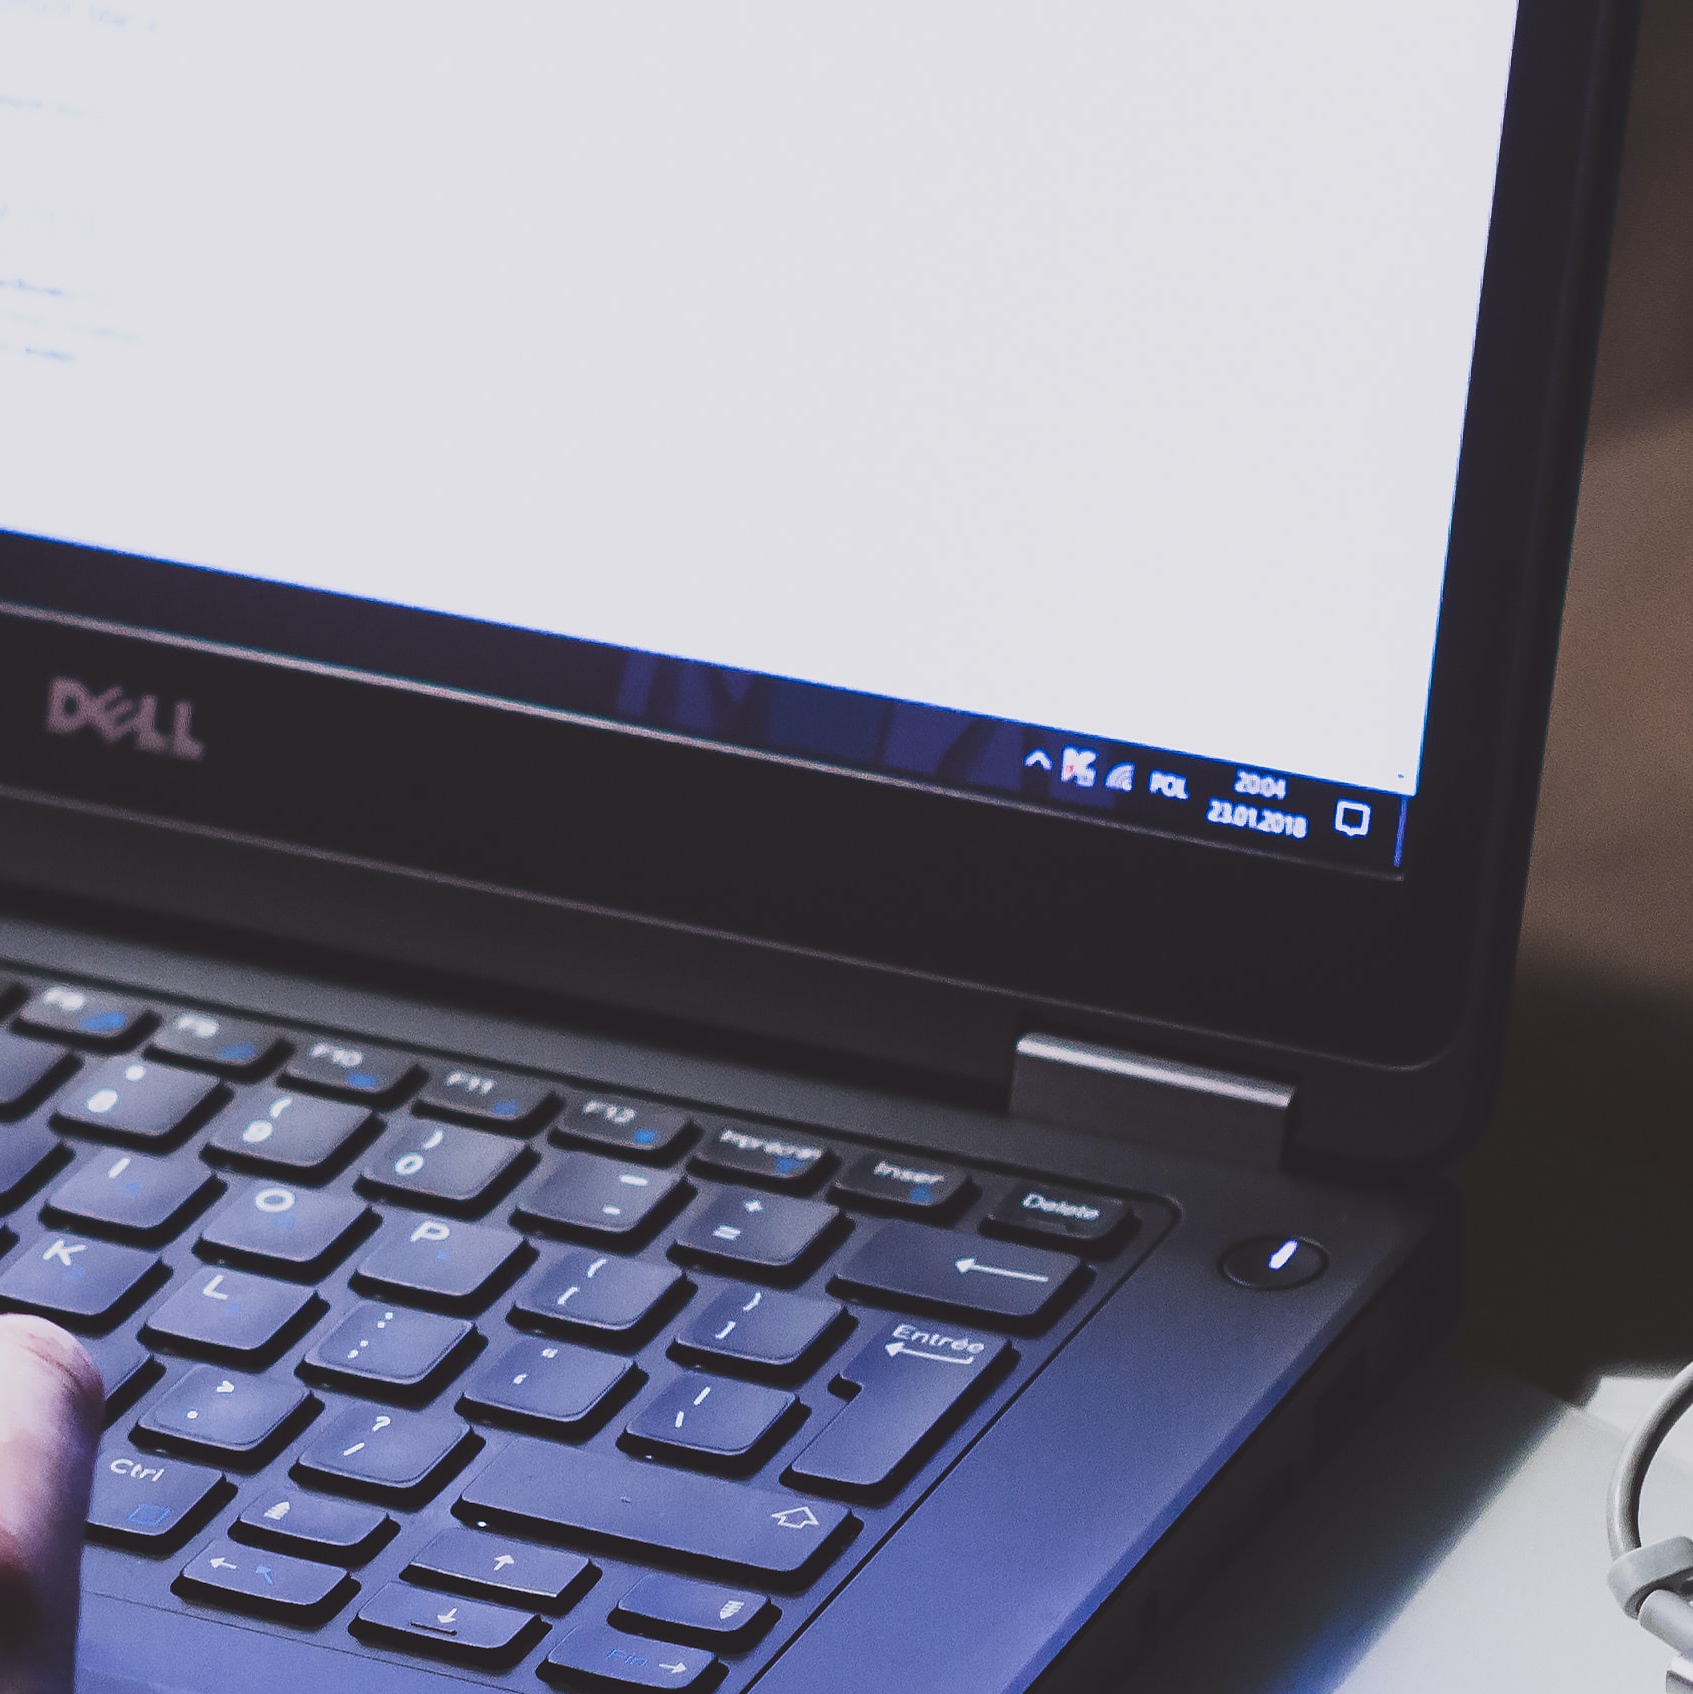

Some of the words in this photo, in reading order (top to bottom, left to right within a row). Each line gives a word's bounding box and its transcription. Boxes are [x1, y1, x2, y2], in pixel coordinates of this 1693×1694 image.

[46, 675, 207, 762] DELL
[1149, 771, 1188, 800] POL
[446, 1071, 495, 1094] F11
[108, 1157, 131, 1179] I
[254, 1188, 295, 1213] O
[1022, 1193, 1100, 1220] Delete
[410, 1220, 451, 1242] P
[42, 1239, 86, 1266] K
[202, 1274, 229, 1300] L
[892, 1322, 986, 1354] Entrée
[109, 1458, 165, 1482] Ctrl
[606, 1648, 648, 1668] Fin
